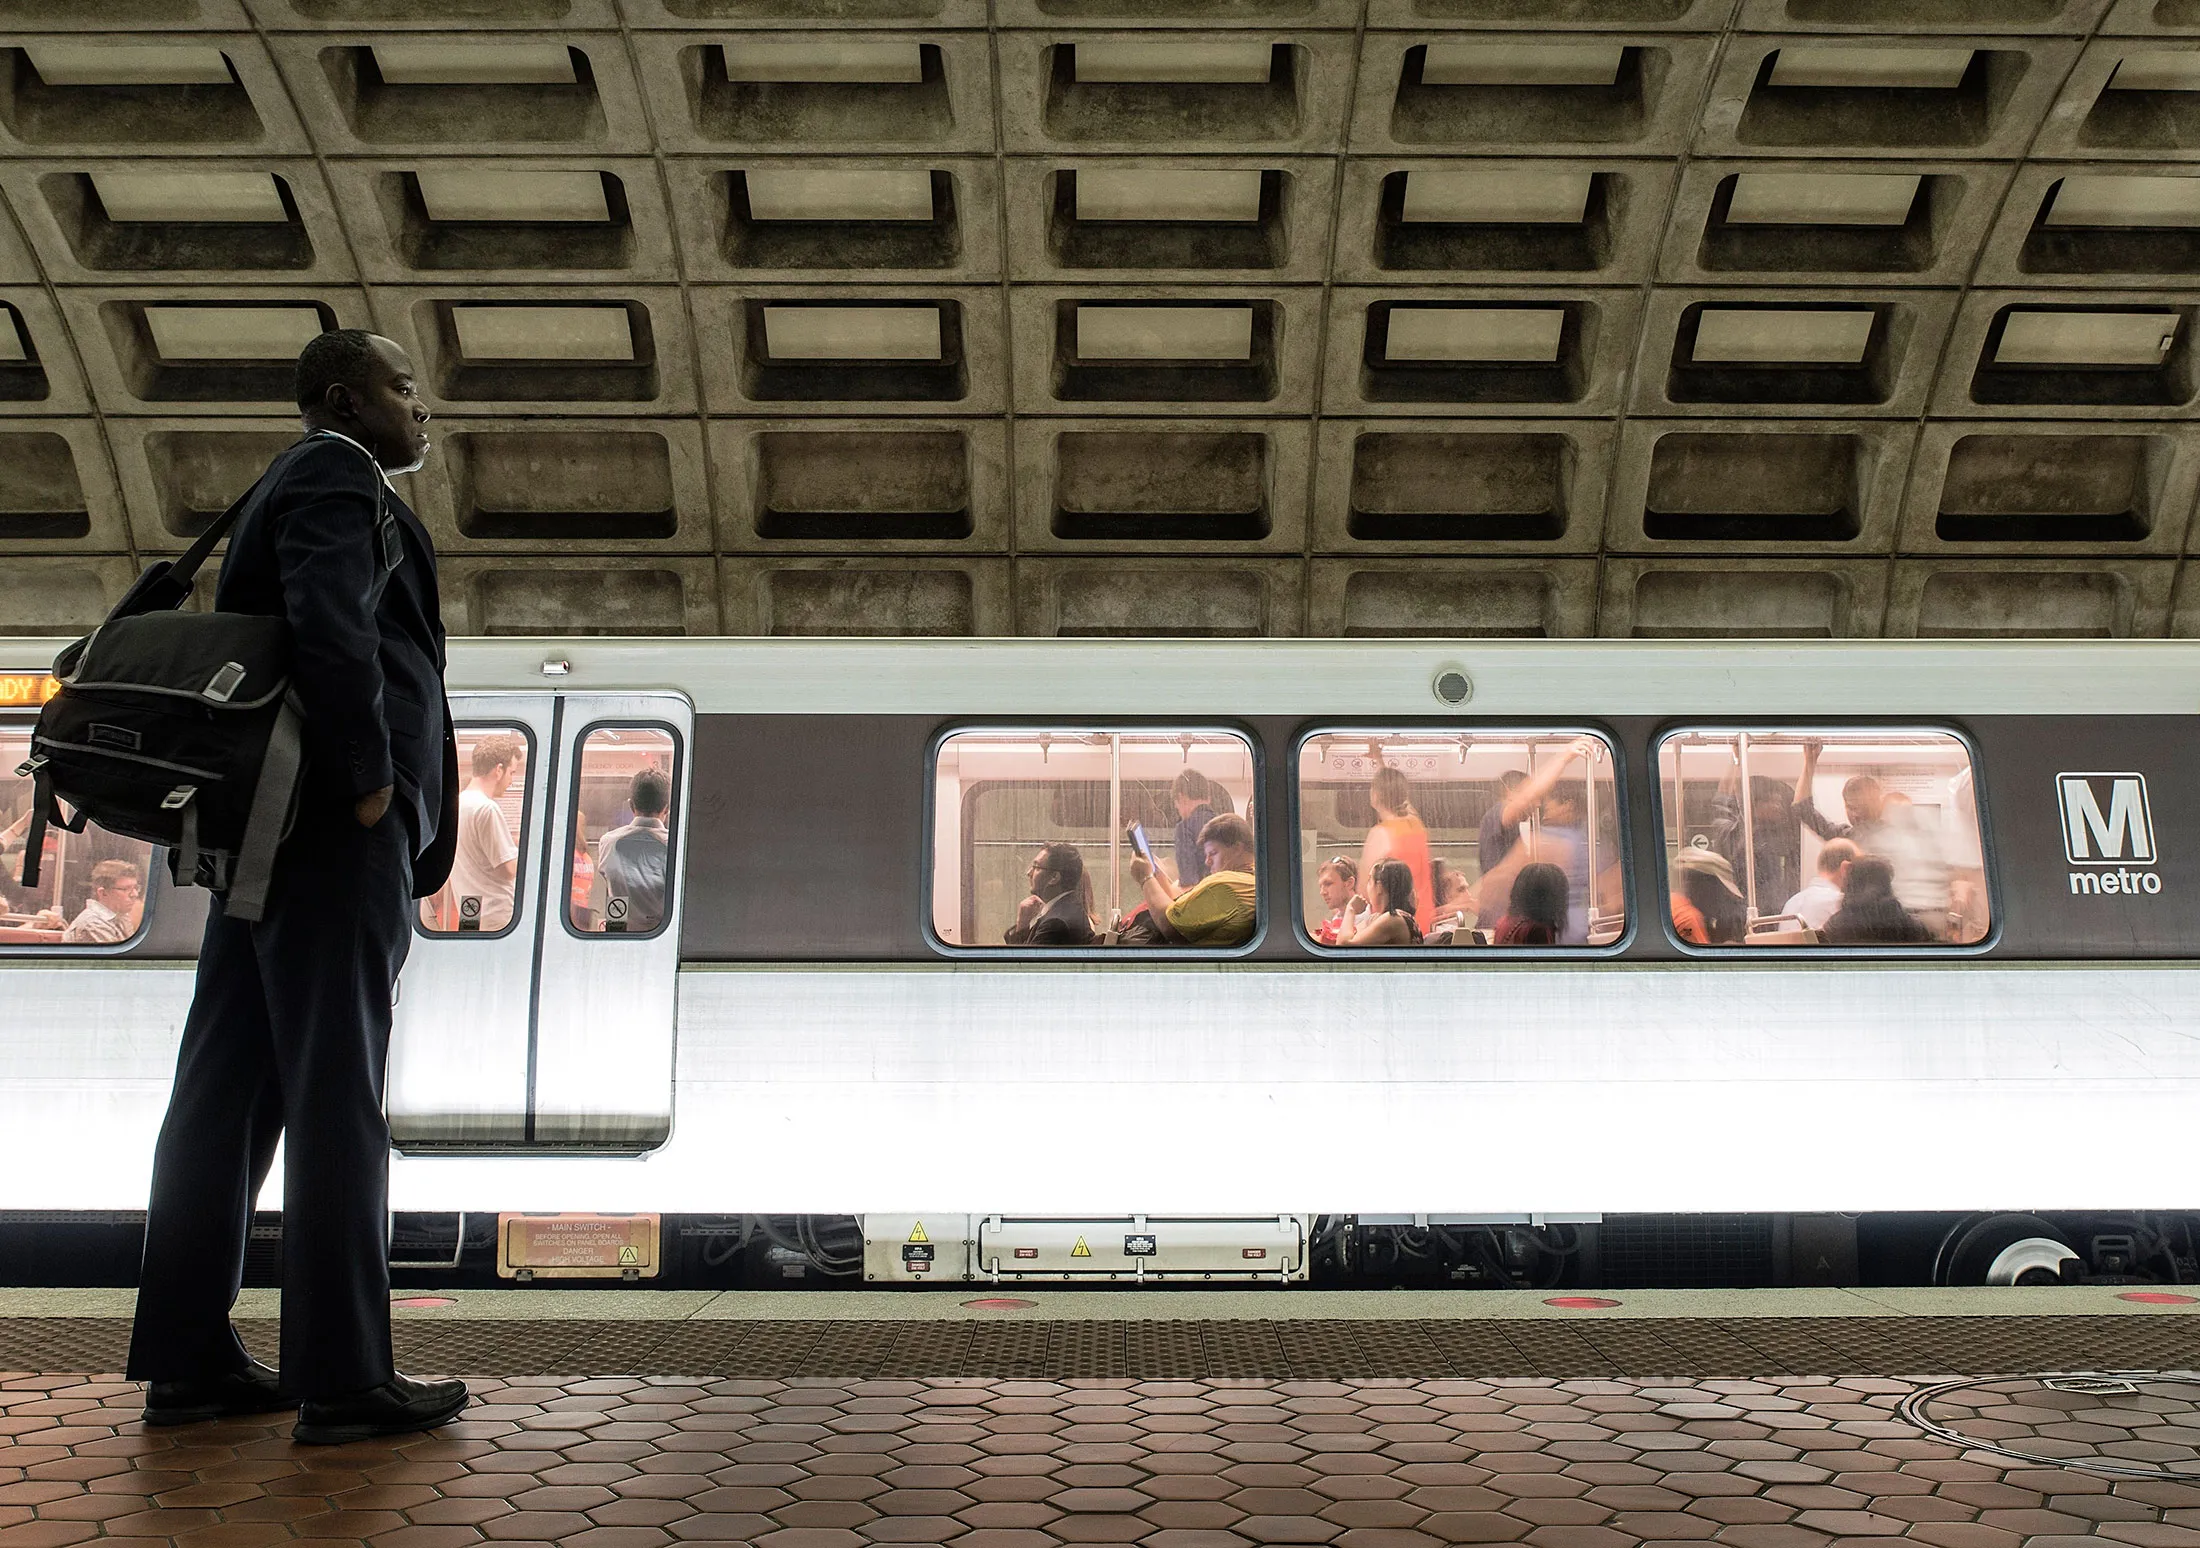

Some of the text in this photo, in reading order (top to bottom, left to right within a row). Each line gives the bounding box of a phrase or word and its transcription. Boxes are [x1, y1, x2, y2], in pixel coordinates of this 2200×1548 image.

[0, 677, 33, 700] DY
[2062, 779, 2150, 858] M
[2069, 868, 2162, 894] metro
[573, 1223, 606, 1231] SWITCH
